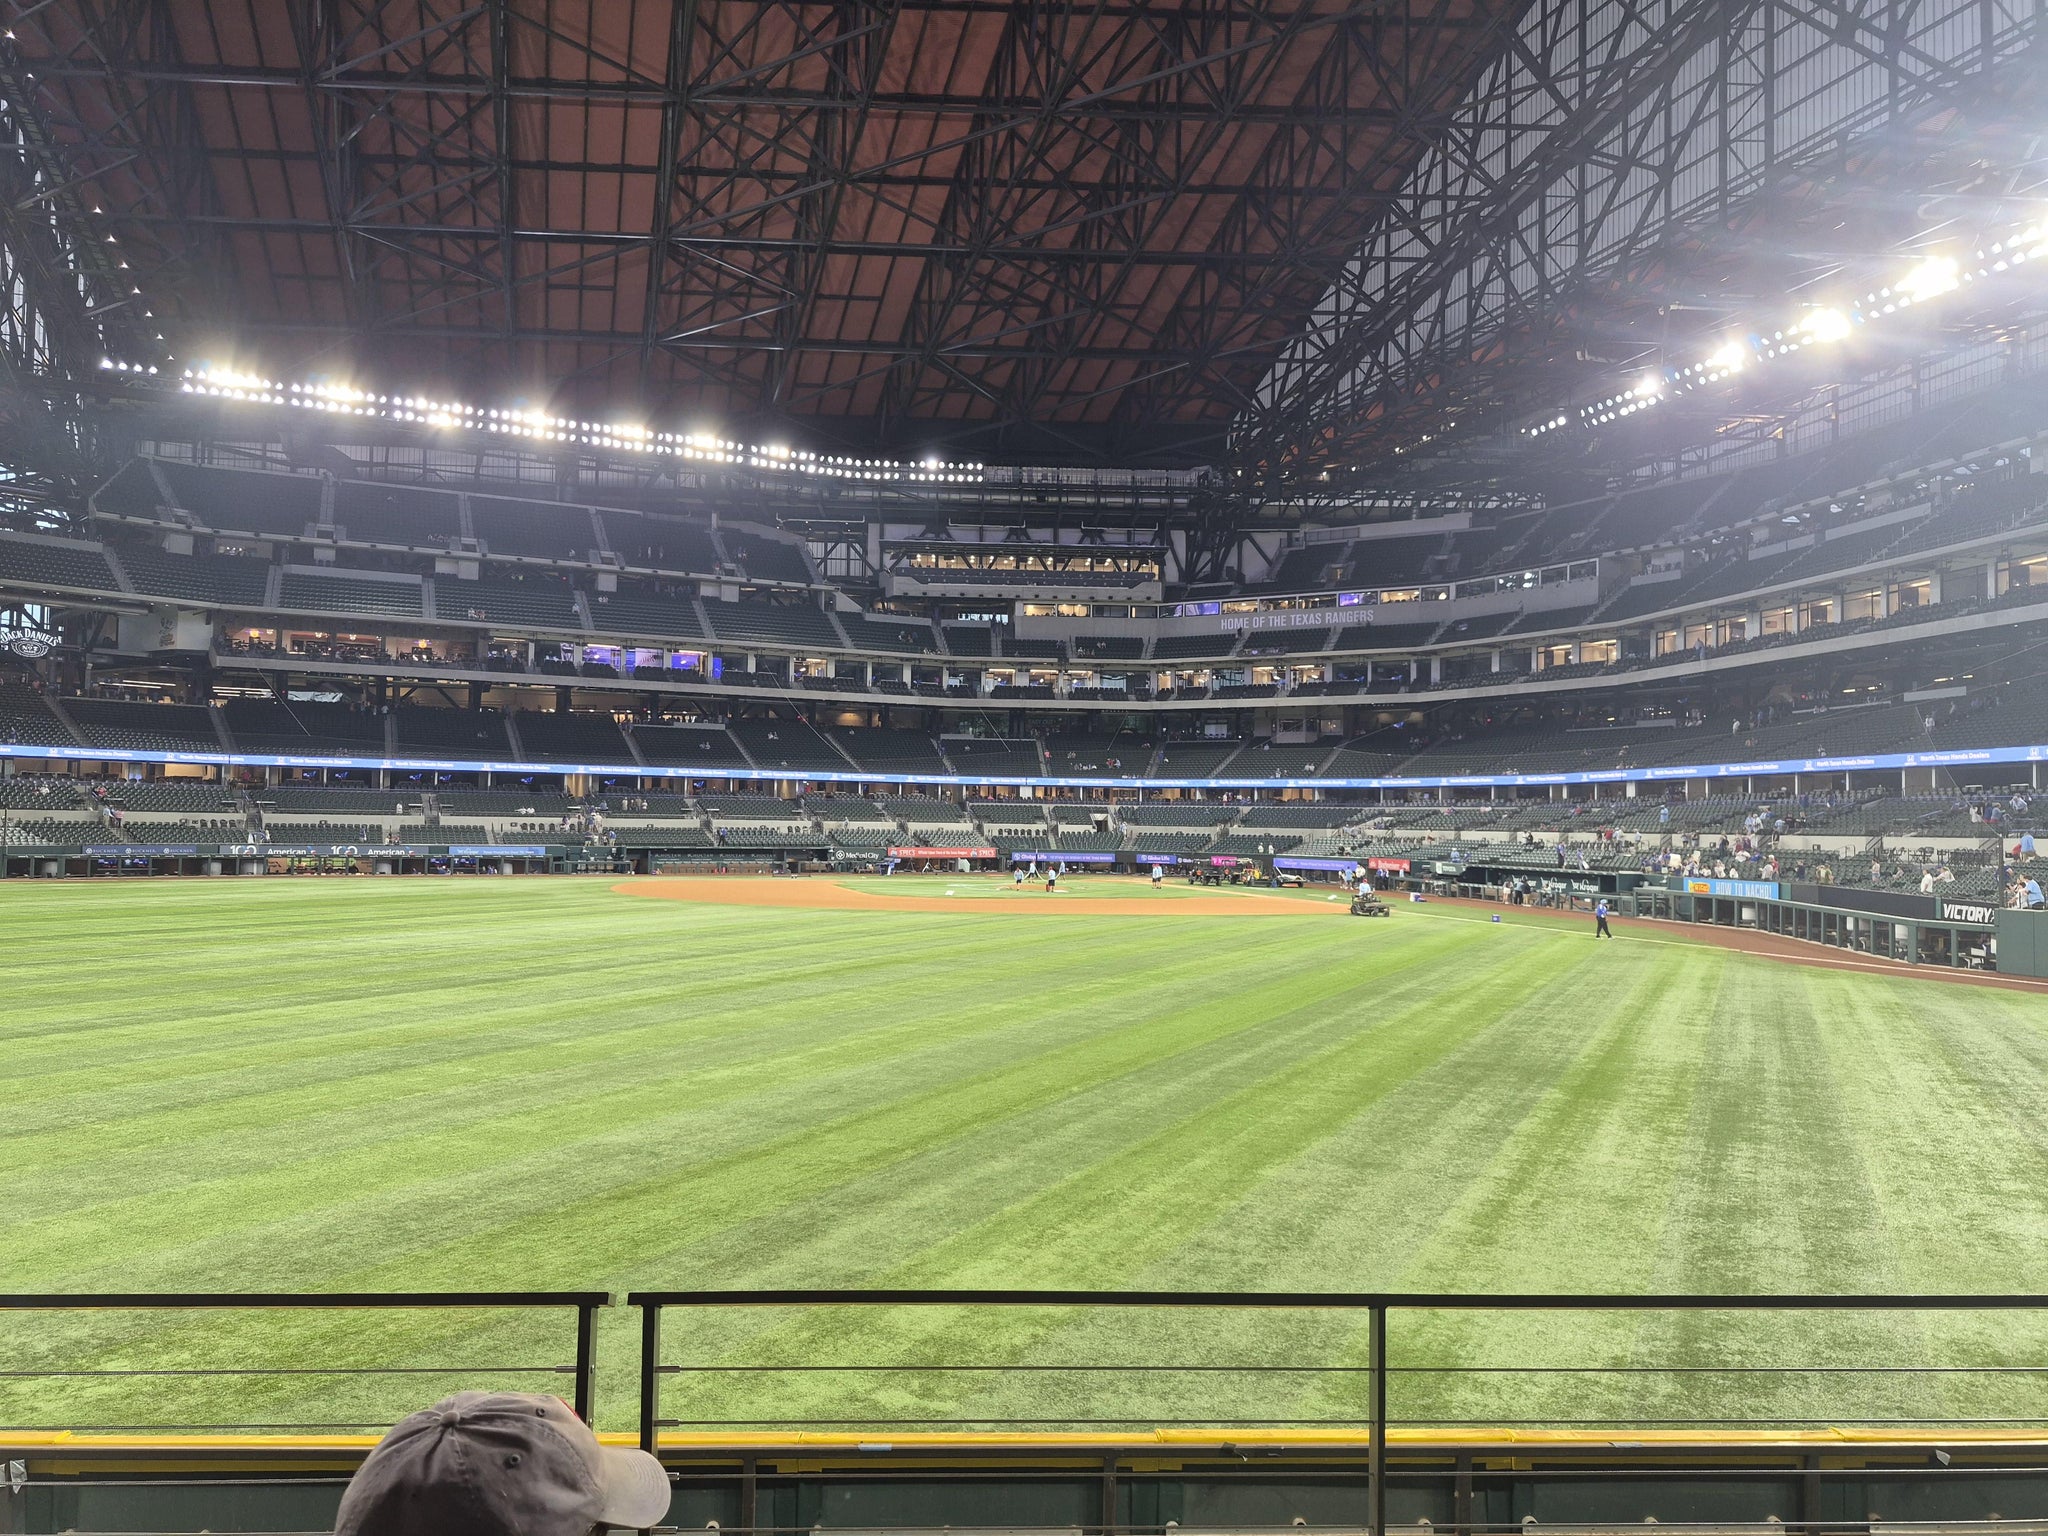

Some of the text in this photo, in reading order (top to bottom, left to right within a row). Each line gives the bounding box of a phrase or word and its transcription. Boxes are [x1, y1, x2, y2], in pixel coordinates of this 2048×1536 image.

[1221, 610, 1374, 630] HOME OF THE TEXAS RANGERS
[0, 628, 58, 647] JACK DANIEL'S
[1580, 879, 1599, 893] Kroger
[1735, 882, 1743, 896] TO
[1943, 903, 1992, 923] VICTORY
